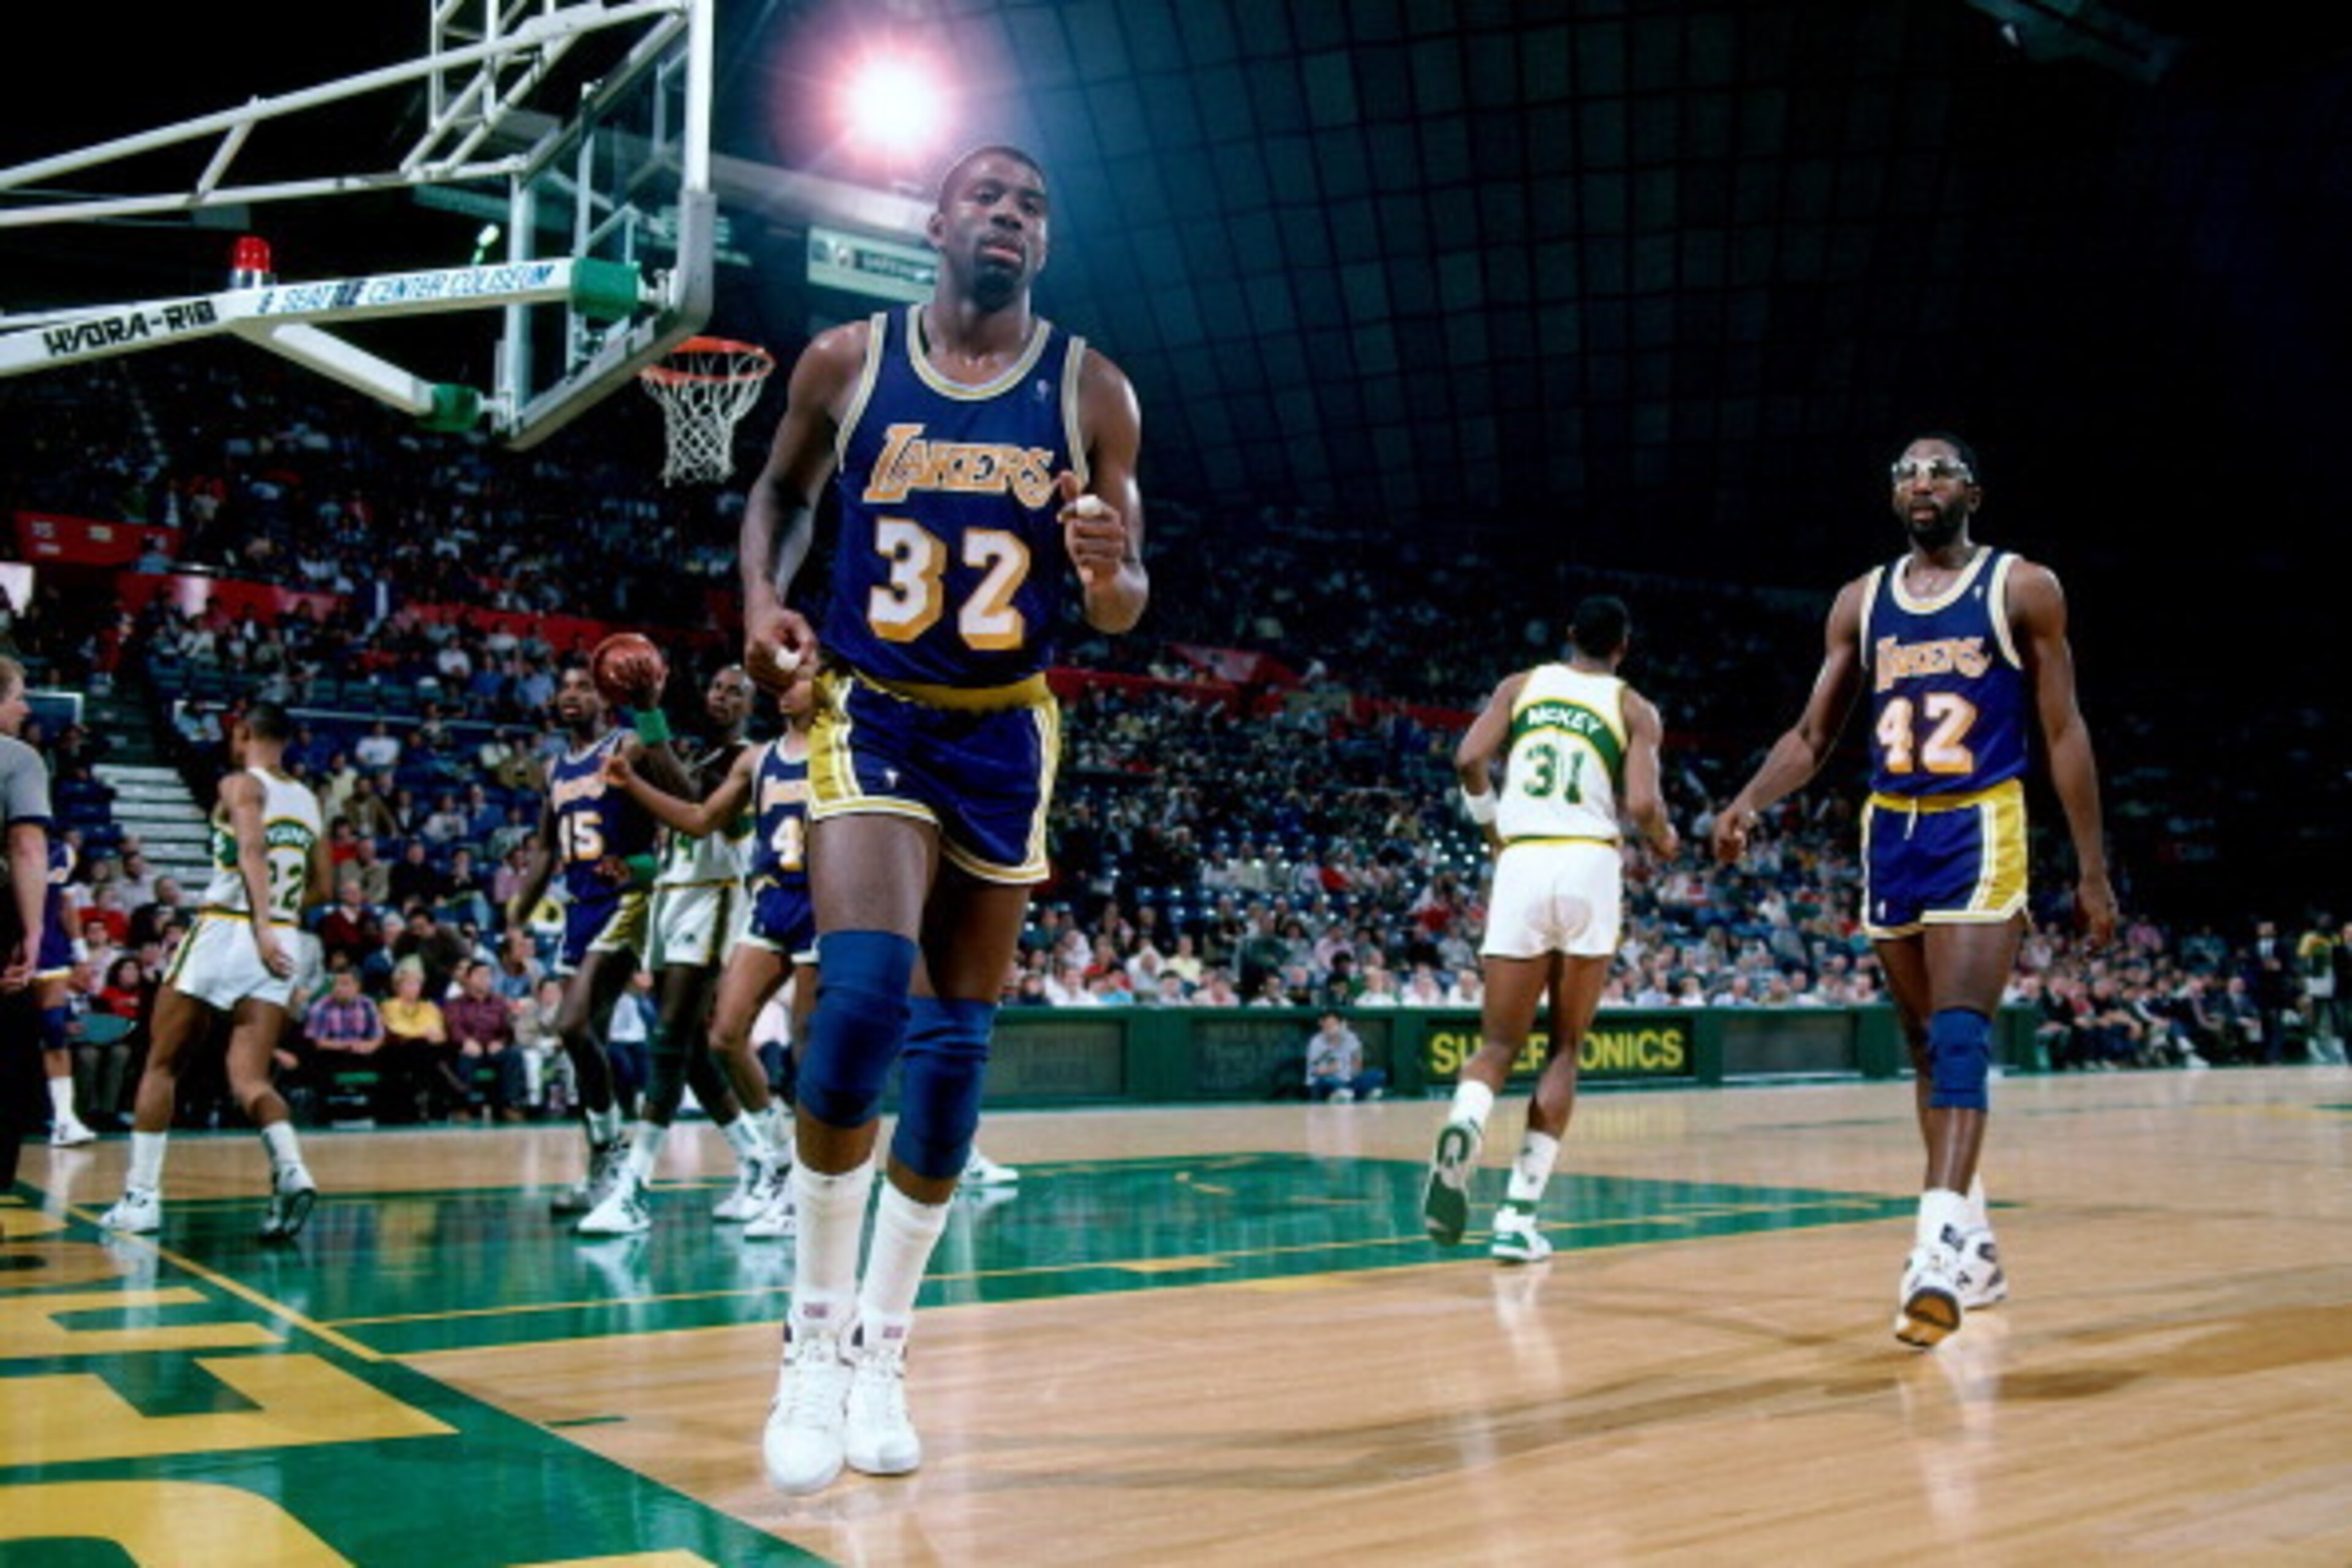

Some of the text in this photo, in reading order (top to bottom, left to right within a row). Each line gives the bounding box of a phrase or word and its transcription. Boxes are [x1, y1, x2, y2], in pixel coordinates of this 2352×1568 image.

[368, 273, 448, 302] CENTER
[450, 264, 555, 297] COLISEUM
[867, 516, 1031, 650] 32
[1875, 693, 1977, 774] 42
[1523, 742, 1585, 805] 31
[558, 811, 603, 864] 15
[1431, 1030, 1684, 1074] SURONICS
